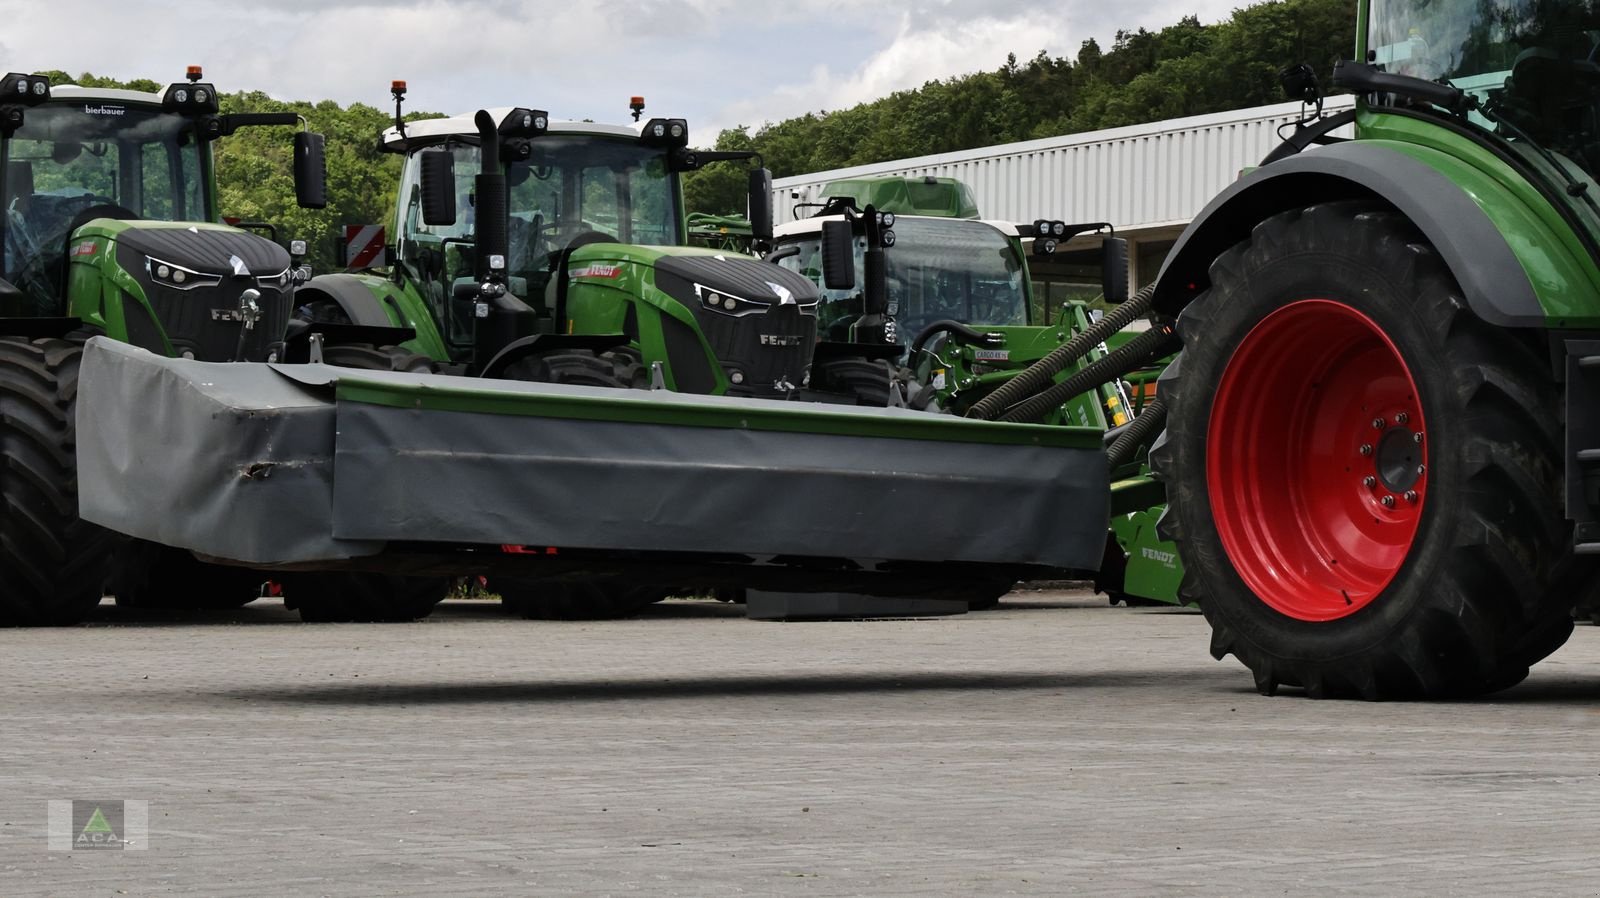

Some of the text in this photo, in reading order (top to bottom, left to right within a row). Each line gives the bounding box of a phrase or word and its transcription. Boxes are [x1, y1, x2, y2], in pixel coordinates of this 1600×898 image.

[85, 104, 125, 115] bierbauer
[591, 264, 615, 277] FENDT
[211, 309, 264, 321] FEN
[1142, 547, 1176, 563] FENDT
